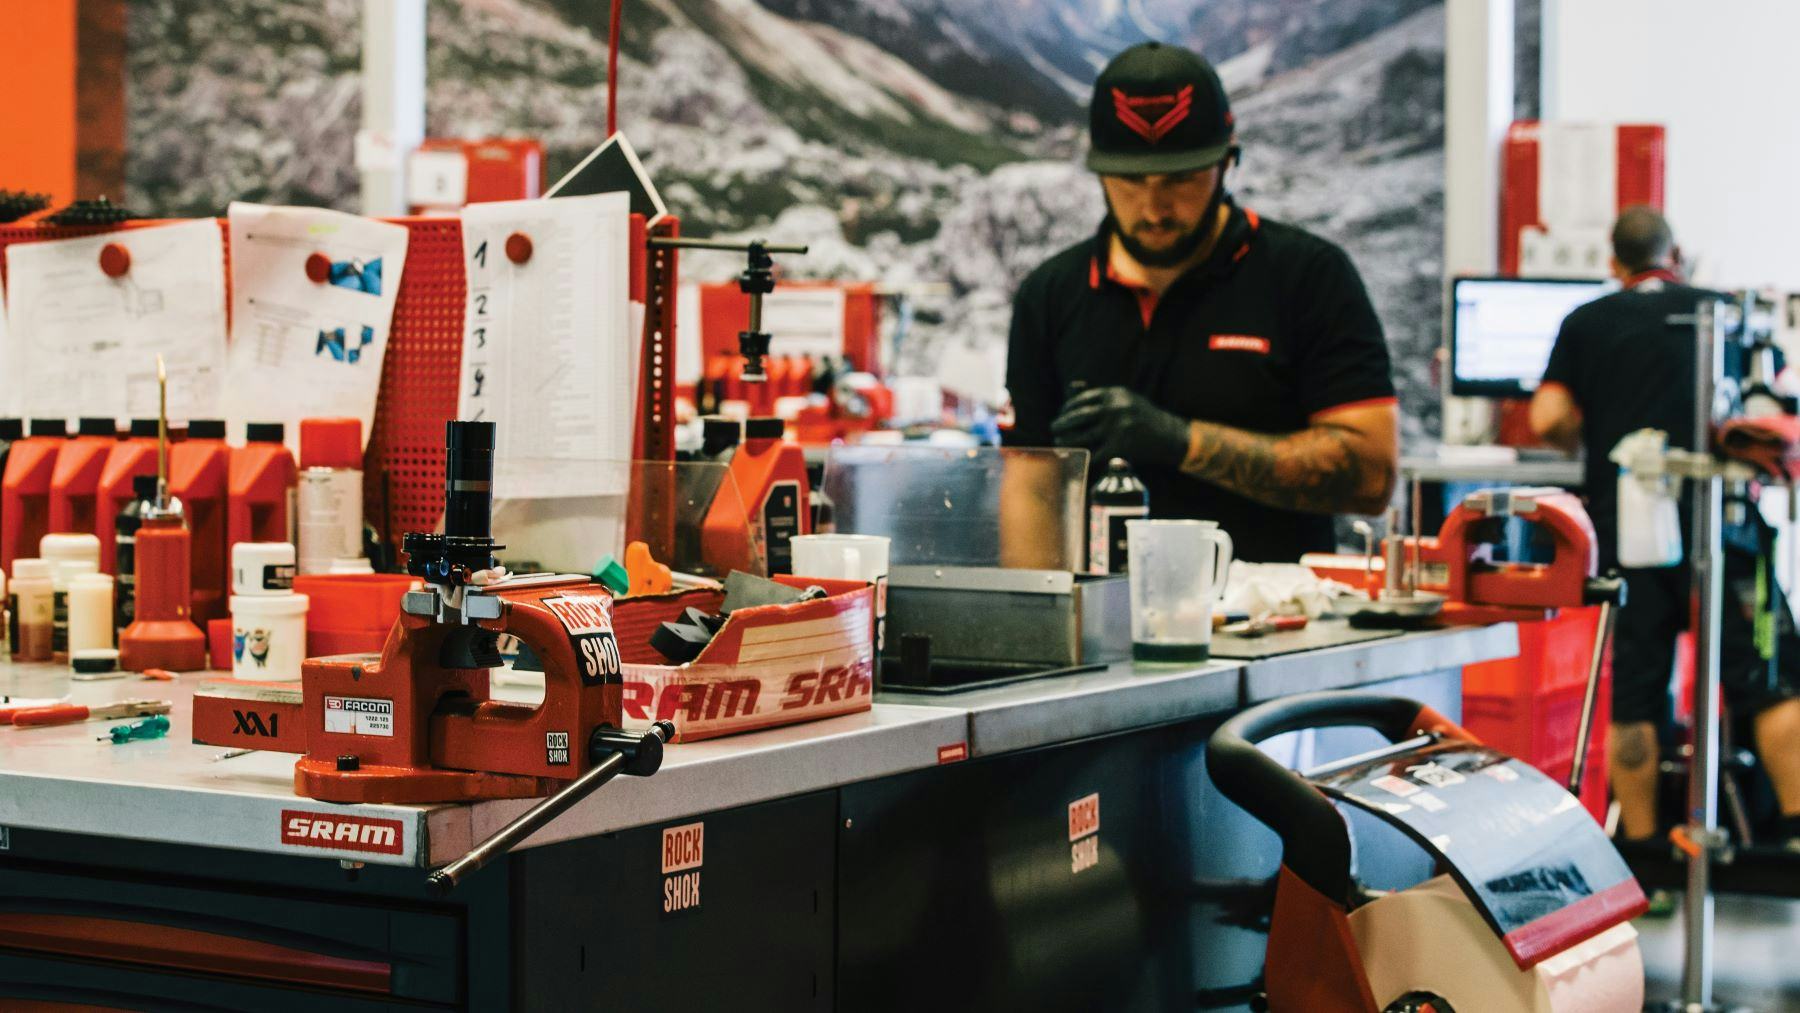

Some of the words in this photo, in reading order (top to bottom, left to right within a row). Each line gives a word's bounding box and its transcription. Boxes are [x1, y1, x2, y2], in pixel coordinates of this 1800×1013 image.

[474, 241, 487, 268] 1
[475, 295, 487, 314] 2
[473, 328, 486, 348] 3
[580, 637, 619, 677] SHO
[623, 678, 761, 722] RAM
[783, 664, 871, 710] SRA
[345, 701, 390, 713] FACOM
[548, 734, 567, 748] ROCK
[548, 750, 568, 763] SHOX
[287, 818, 395, 846] SRAM
[665, 827, 701, 868] ROCK
[664, 871, 700, 913] SHOX
